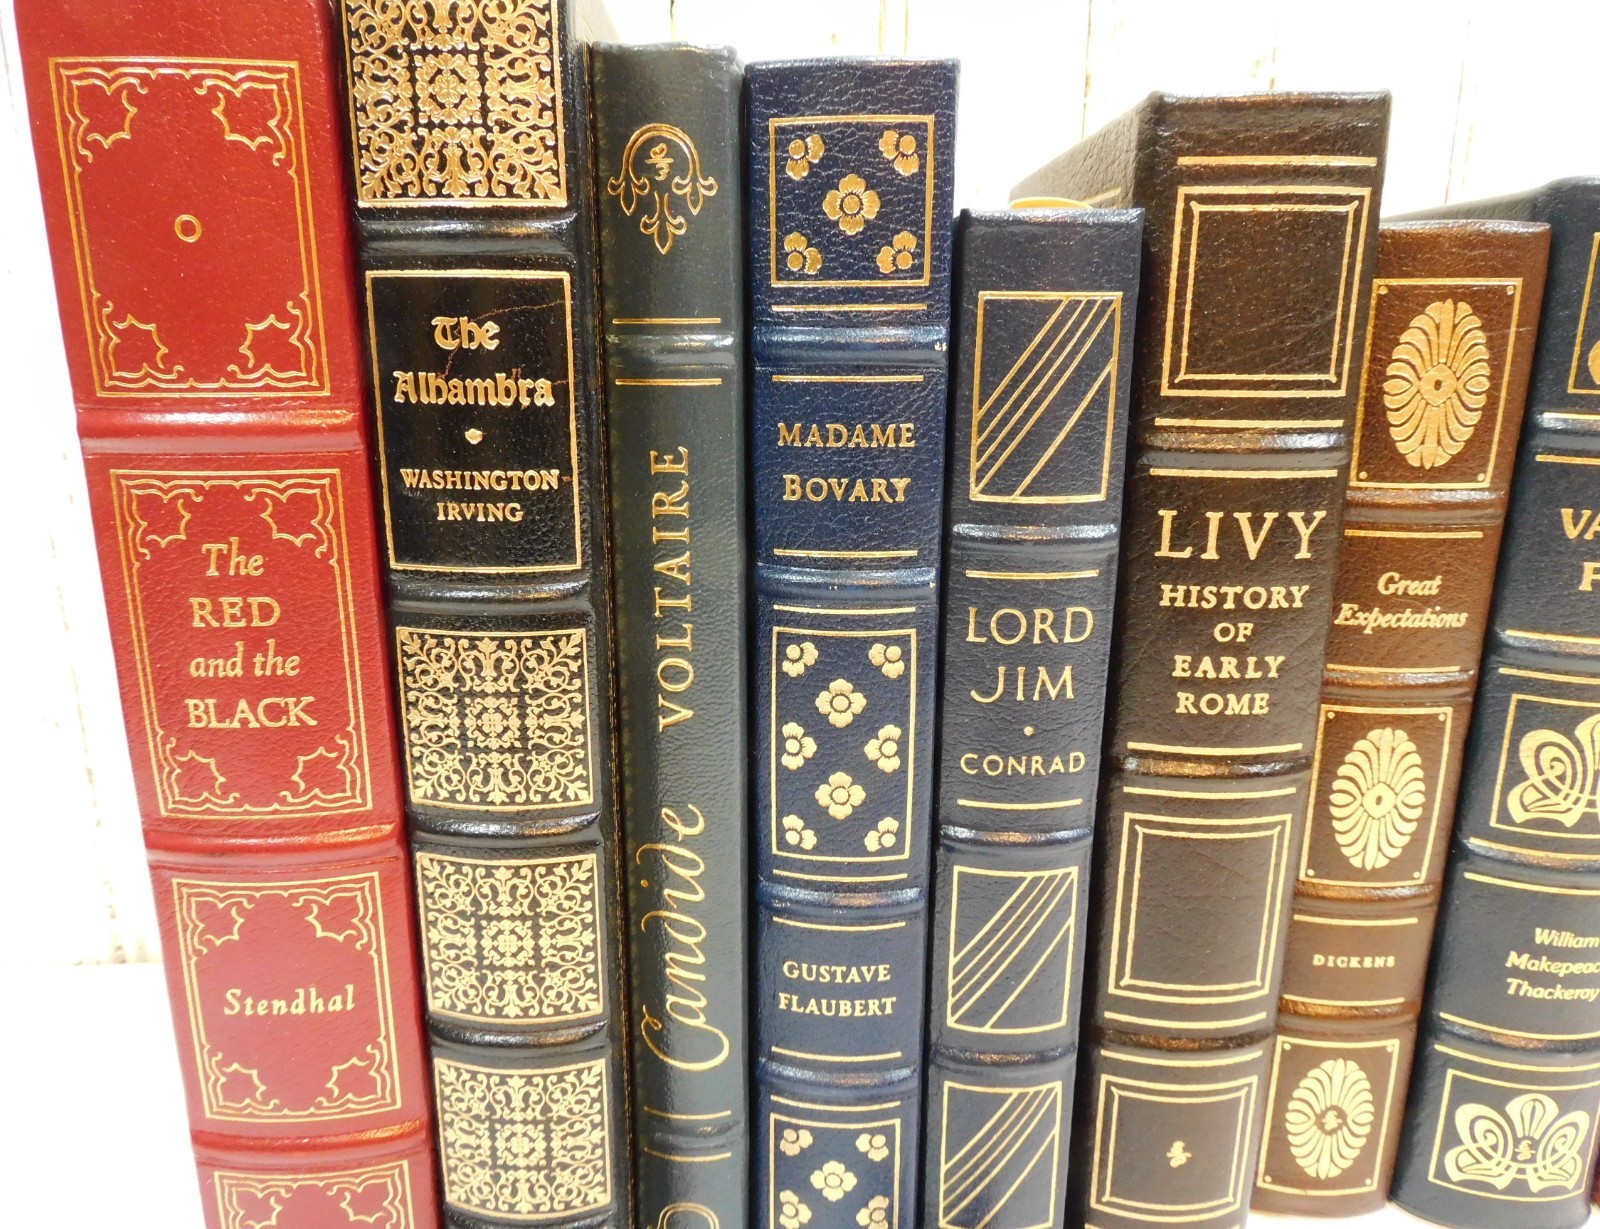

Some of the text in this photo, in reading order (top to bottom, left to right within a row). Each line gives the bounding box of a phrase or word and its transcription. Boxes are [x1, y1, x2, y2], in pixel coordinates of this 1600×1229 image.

[432, 316, 500, 350] The
[393, 370, 556, 407] Alhambra
[777, 422, 917, 448] MADAME
[400, 469, 560, 491] WASHINGTON
[782, 474, 912, 503] BOVARY
[436, 502, 524, 522] IRVING
[1154, 509, 1327, 561] LIVY
[201, 537, 265, 577] The
[650, 446, 694, 732] VOLTAIRE
[1159, 584, 1310, 610] HISTORY
[1377, 571, 1443, 596] Great
[188, 596, 281, 628] RED
[965, 606, 1094, 645] LORD
[1333, 602, 1469, 635] Expectations
[1213, 622, 1254, 643] OF
[189, 638, 301, 678] and the
[1171, 654, 1286, 679] EARLY
[970, 665, 1075, 703] JIM
[184, 696, 318, 729] BLACK
[1175, 691, 1270, 715] ROME
[960, 751, 1086, 777] CONRAD
[635, 803, 730, 1072] Candide
[1534, 926, 1600, 949] William
[782, 960, 891, 984] GUSTAVE
[1312, 953, 1396, 969] DICKENS
[223, 983, 356, 1017] Stendhal
[1505, 977, 1600, 1003] Thackeray
[778, 992, 897, 1017] FLAUBERT
